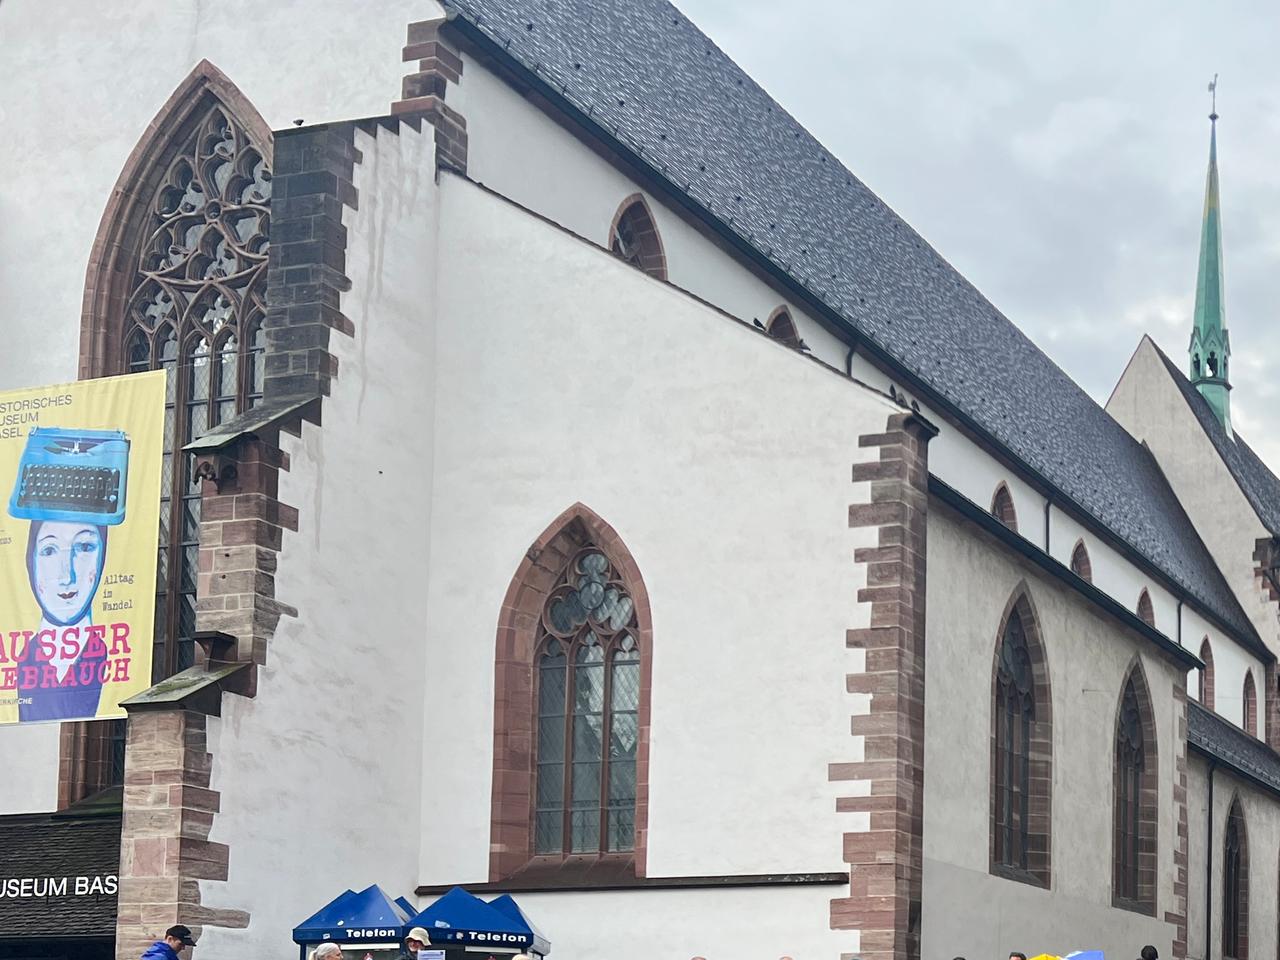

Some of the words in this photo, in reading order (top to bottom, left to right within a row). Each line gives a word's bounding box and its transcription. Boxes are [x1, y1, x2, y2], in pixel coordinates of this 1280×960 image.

[0, 427, 23, 439] SEL
[104, 573, 135, 585] Alltag
[103, 589, 112, 599] im
[102, 599, 133, 611] Wandel
[346, 928, 396, 938] Telefon
[468, 931, 527, 943] Telefon
